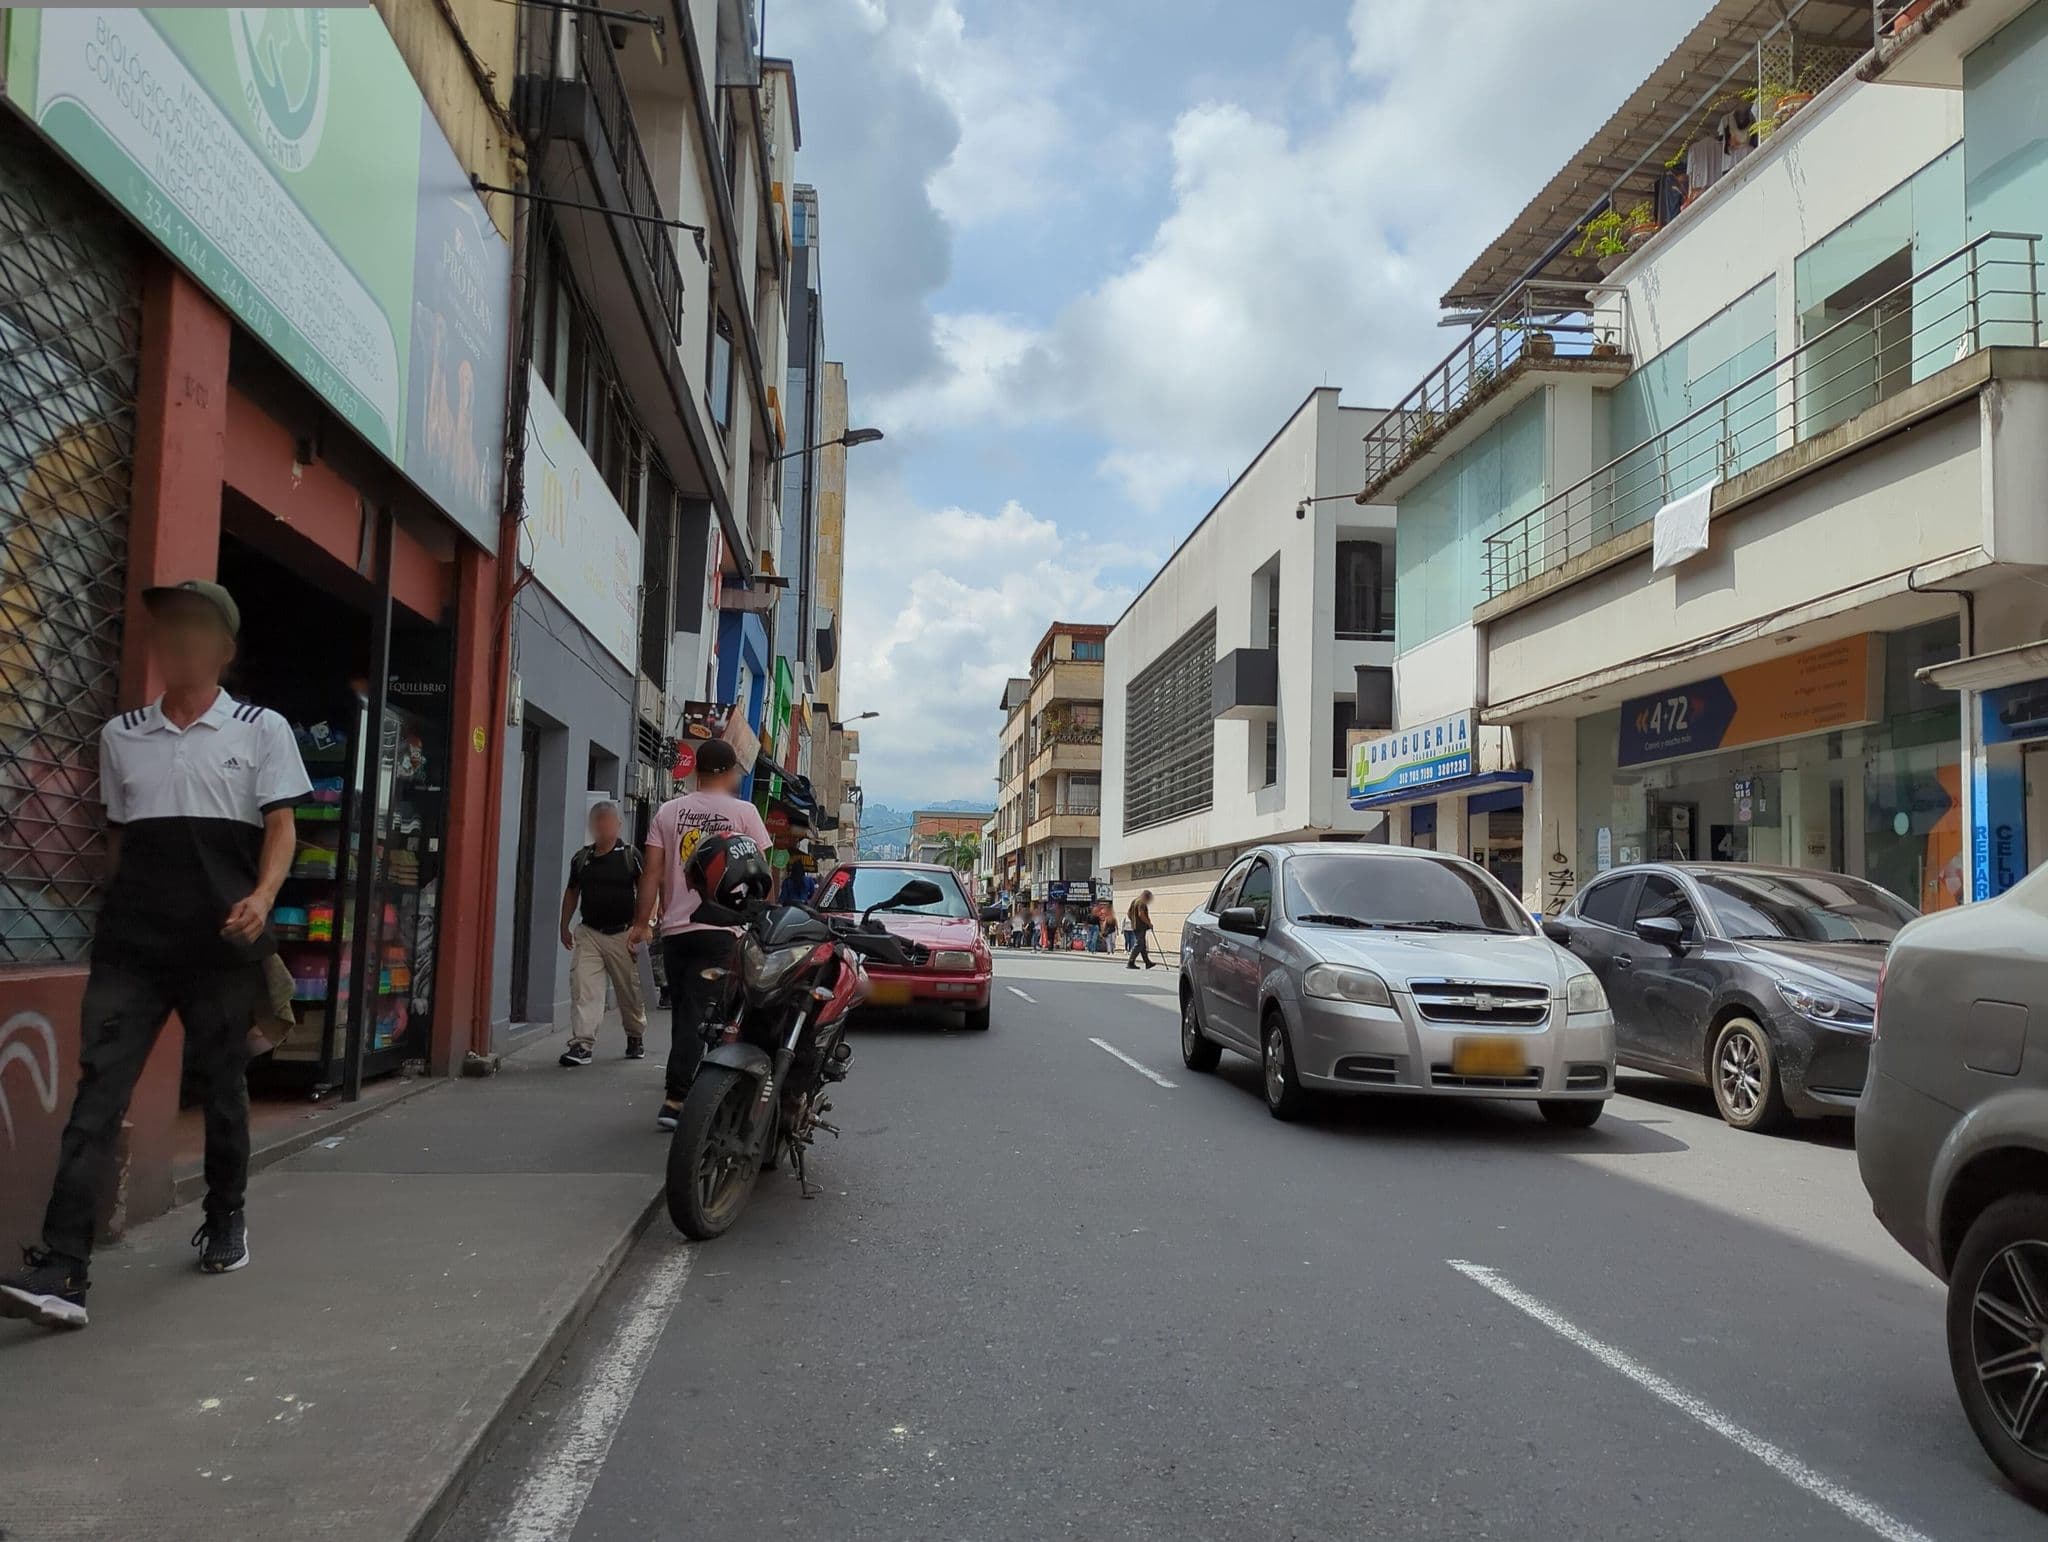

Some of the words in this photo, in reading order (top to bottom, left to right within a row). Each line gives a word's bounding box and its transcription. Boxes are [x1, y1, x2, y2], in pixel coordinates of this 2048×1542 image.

[85, 41, 162, 145] CONSULTA
[96, 15, 182, 134] BIOLÓGICOS
[180, 81, 271, 207] MEDICAMENTOS
[265, 126, 303, 169] CENTRO
[144, 191, 171, 238] 334
[176, 225, 208, 273] 1144
[220, 267, 244, 310] 346
[156, 152, 237, 257] INSECTICIDAS
[1371, 718, 1467, 764] DROGUERÍA
[678, 808, 713, 825] Happy
[702, 822, 734, 833] Nation
